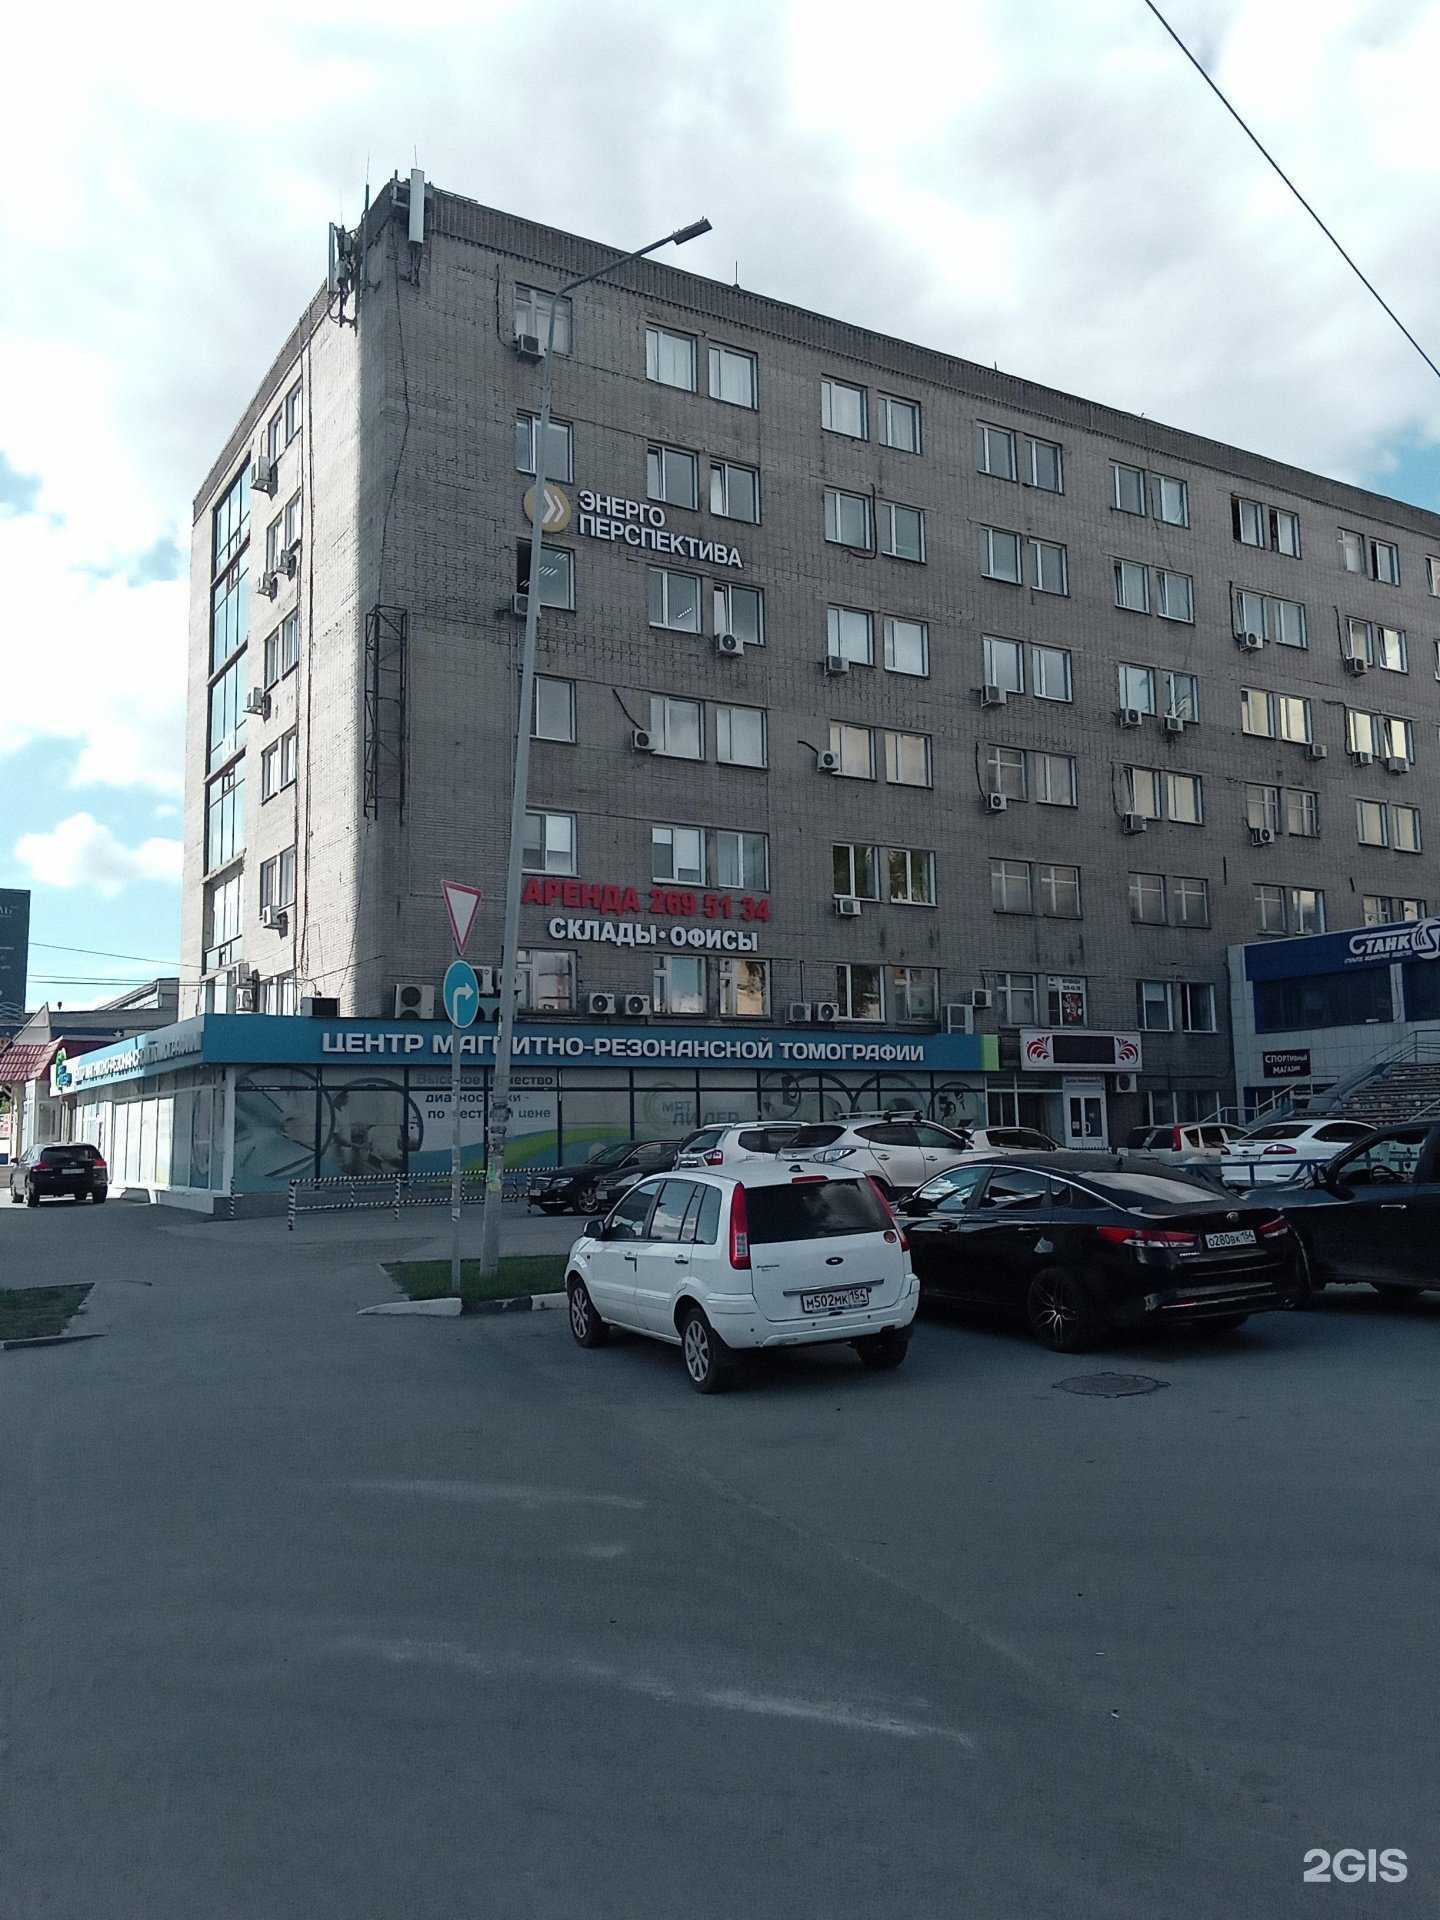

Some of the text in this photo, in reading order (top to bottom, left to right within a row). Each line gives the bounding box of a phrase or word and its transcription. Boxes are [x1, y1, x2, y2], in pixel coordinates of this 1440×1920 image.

[579, 490, 665, 527] ЭНЕРГО
[579, 514, 743, 568] ПЕРСПЕКТИВА
[522, 878, 641, 915] АРЕНДА
[704, 894, 732, 919] 51
[741, 896, 771, 922] 34
[549, 917, 759, 951] СКЛАДЫ ОФИСЫ
[322, 1032, 424, 1053] ЦЕНТР
[779, 1042, 924, 1062] ТОМОГРАФИИ
[428, 1111, 445, 1119] по
